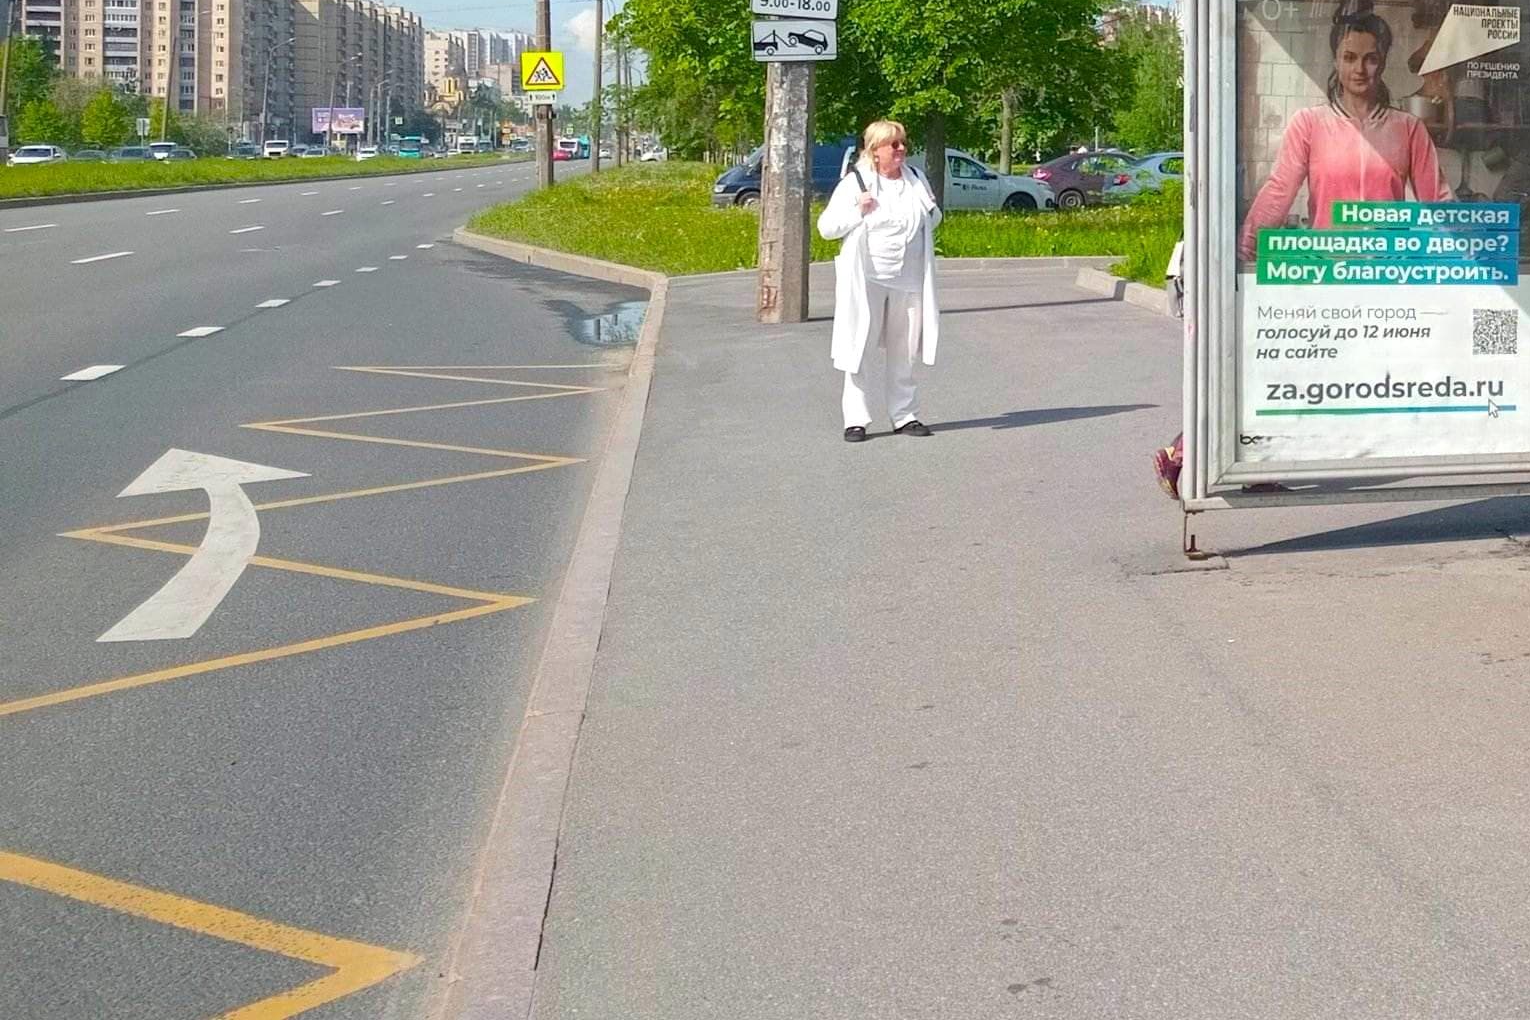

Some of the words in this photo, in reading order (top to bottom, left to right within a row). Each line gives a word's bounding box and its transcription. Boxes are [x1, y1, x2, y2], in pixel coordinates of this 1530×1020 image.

[1453, 6, 1519, 19] НАЦИОНАЛЬНЫЕ
[1481, 18, 1519, 29] ПРОЕКТЫ
[1487, 29, 1518, 40] РОССИИ
[1466, 61, 1479, 69] ПО
[1480, 62, 1520, 71] РЕШЕНИЮ
[1466, 70, 1518, 80] ПРЕЗИДЕНТА
[1341, 204, 1412, 223] Новая
[1417, 208, 1510, 225] детская
[1268, 235, 1388, 254] площадка
[1393, 236, 1421, 251] во
[1426, 234, 1510, 256] дворе?
[1266, 261, 1327, 284] Могу
[1332, 260, 1509, 284] благоустроить.
[1256, 305, 1317, 320] Меняй
[1321, 306, 1363, 320] свой
[1366, 306, 1417, 322] город
[1256, 324, 1331, 342] голосуй
[1334, 325, 1358, 341] до
[1362, 325, 1379, 339] 12
[1383, 326, 1431, 339] июня
[1256, 346, 1280, 360] на
[1284, 345, 1338, 359] сайте
[1266, 375, 1504, 404] za.gorodsreda.ru
